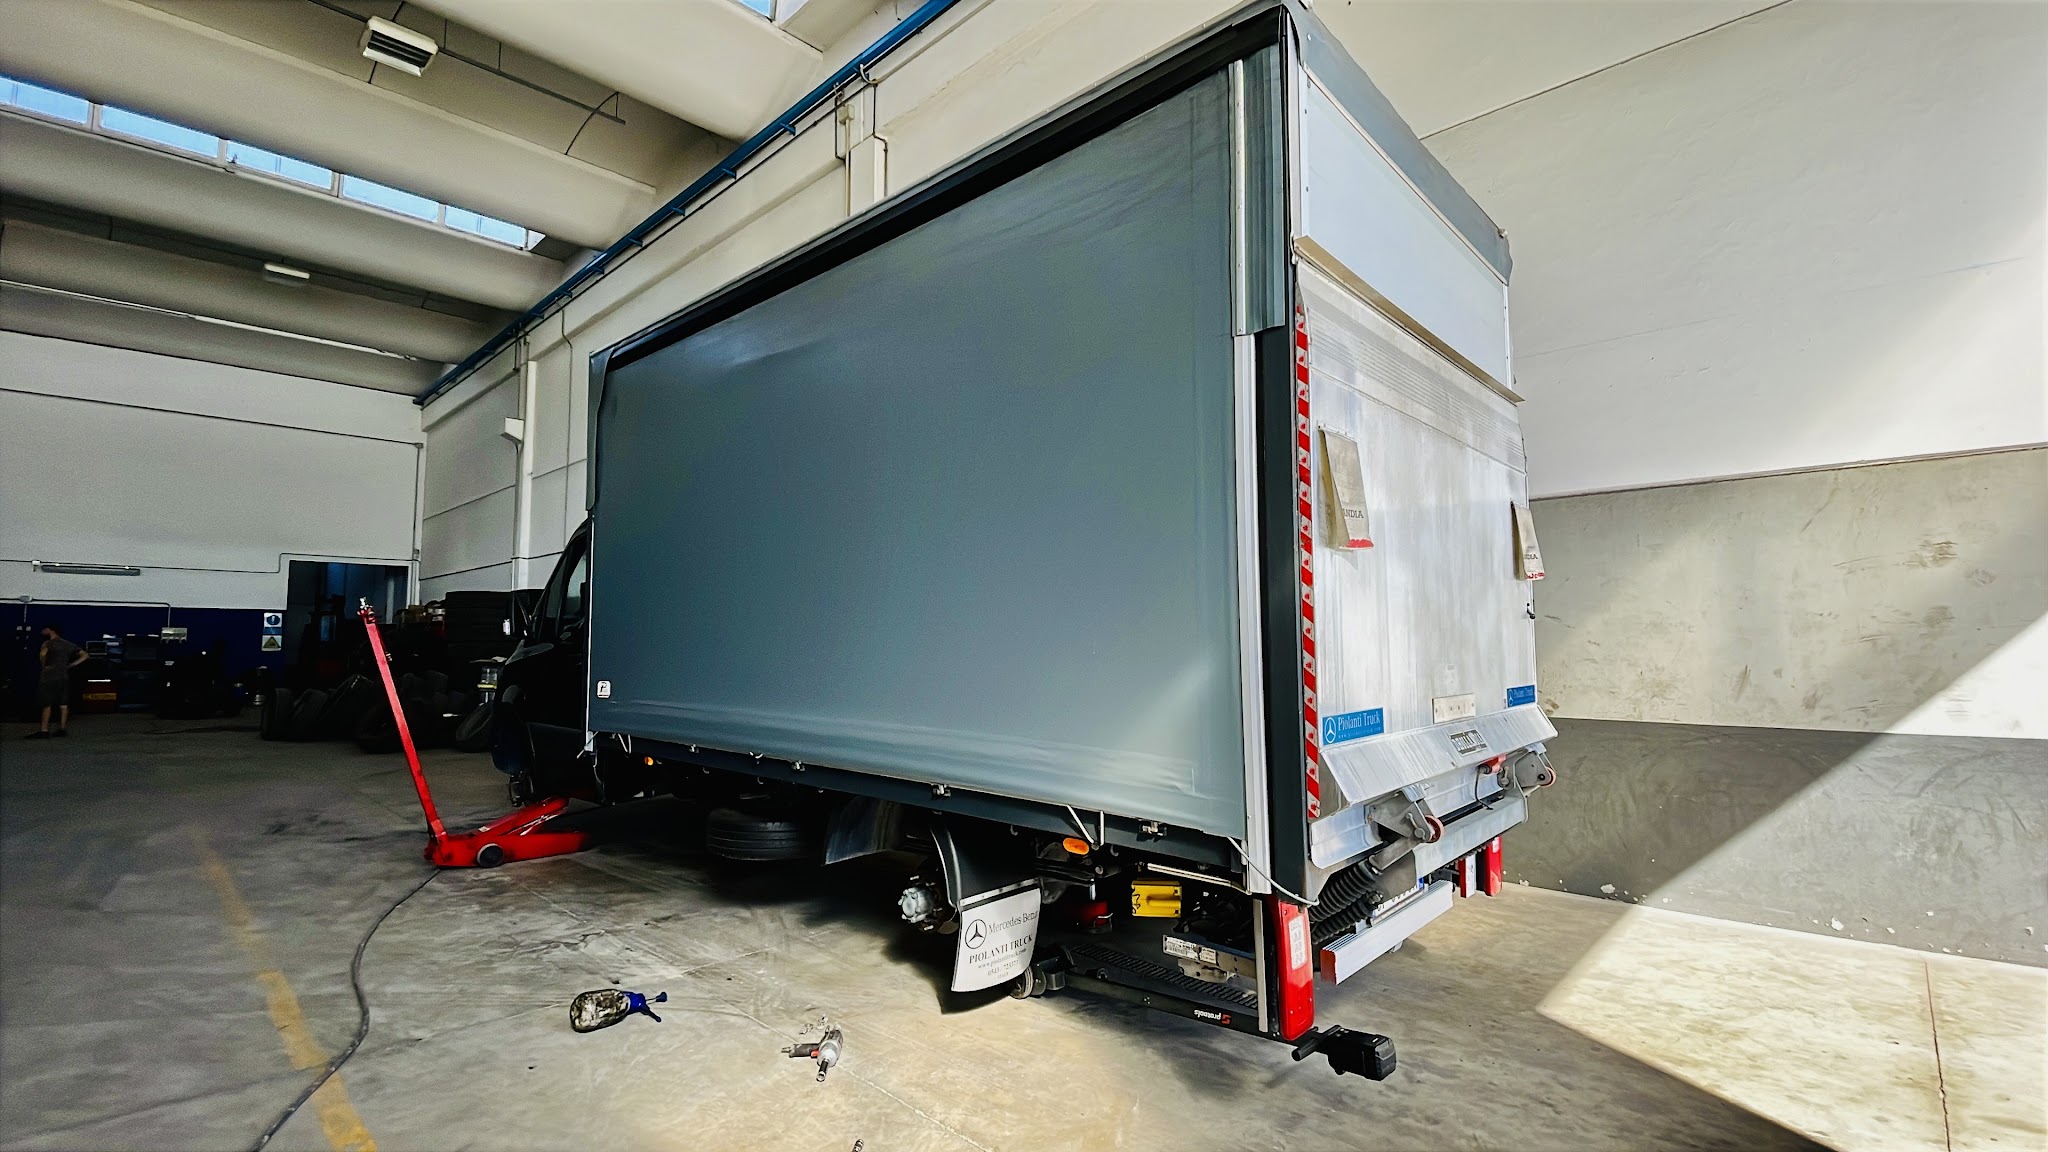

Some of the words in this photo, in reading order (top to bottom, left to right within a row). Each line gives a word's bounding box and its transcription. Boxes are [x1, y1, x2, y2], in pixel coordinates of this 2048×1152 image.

[1338, 714, 1362, 731] Piolanti
[1363, 711, 1381, 726] Truck
[988, 916, 1022, 935] Mercedes
[1023, 911, 1039, 924] Benz
[969, 943, 1008, 964] PIOLANTI
[1008, 934, 1033, 950] TRUCK
